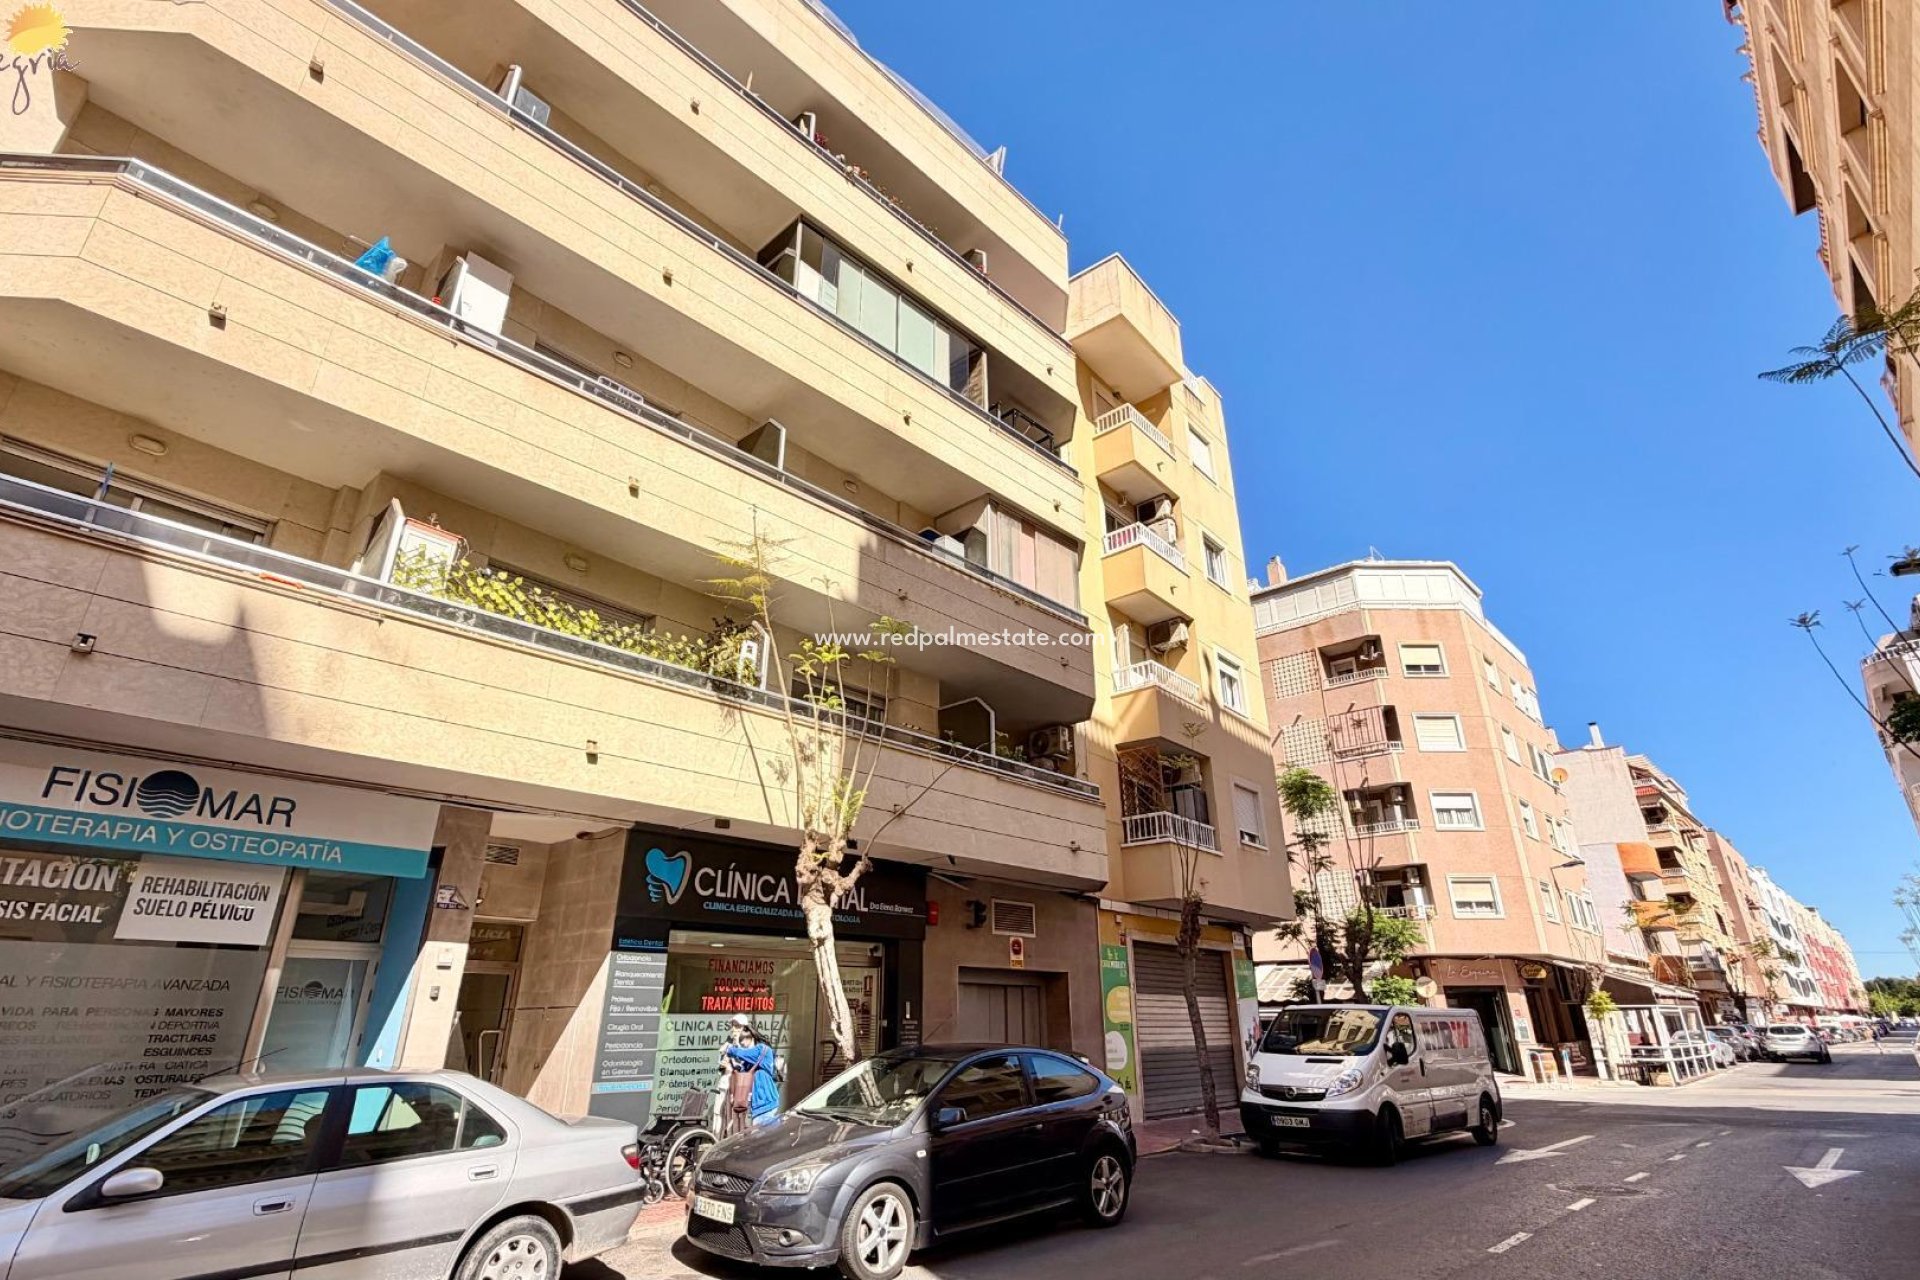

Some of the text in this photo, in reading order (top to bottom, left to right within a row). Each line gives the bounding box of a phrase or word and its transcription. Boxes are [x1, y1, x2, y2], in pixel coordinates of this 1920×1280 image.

[168, 828, 185, 846] Y
[190, 831, 342, 864] OSTEOPATÍA
[141, 876, 270, 901] REHABILITACIÓN
[694, 863, 790, 905] CLÍNICA
[29, 902, 103, 923] FACIAL
[133, 898, 187, 917] SUELO
[703, 901, 735, 912] CLINICA
[736, 905, 792, 917] ESPECIALIZADA
[708, 958, 775, 975] FINANCIAMOS
[26, 976, 37, 987] Y
[40, 976, 147, 990] FISIOTERAPIA
[151, 978, 230, 991] AVANZADA
[714, 977, 767, 993] TODOS SUS
[702, 995, 776, 1011] TRATAMIENTOS
[2, 1007, 34, 1017] VIDA
[42, 1007, 79, 1017] PARA
[165, 1008, 224, 1017] MAYORES
[156, 1021, 220, 1031] DEPORTIVA
[666, 1020, 713, 1032] CLINICA
[678, 1035, 695, 1046] EN
[143, 1047, 212, 1057] ESGUINCES
[661, 1055, 710, 1064] Ortodoncia
